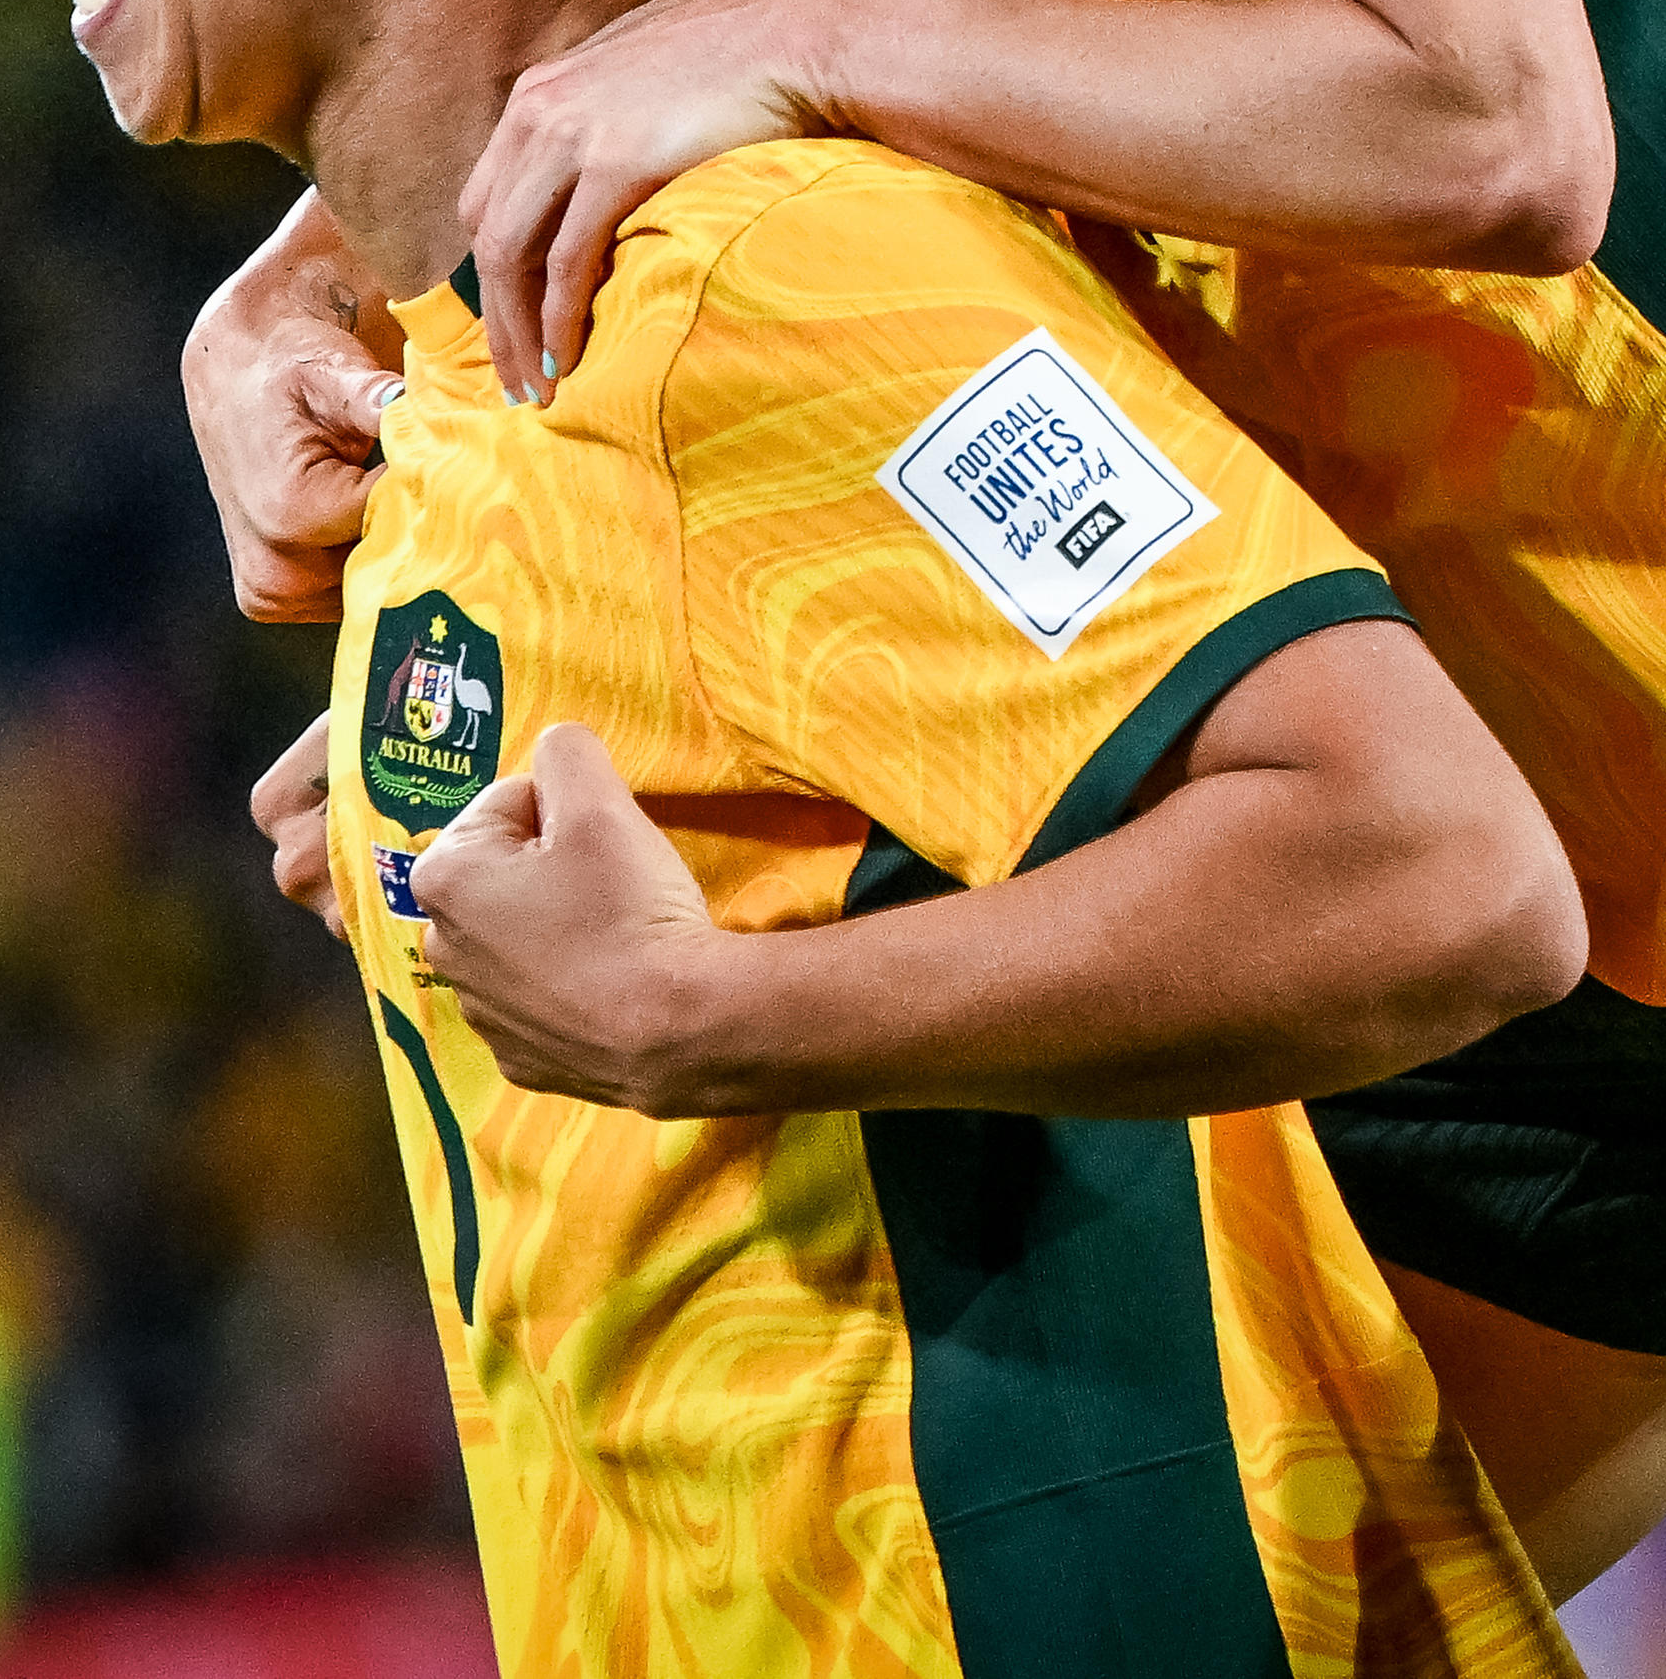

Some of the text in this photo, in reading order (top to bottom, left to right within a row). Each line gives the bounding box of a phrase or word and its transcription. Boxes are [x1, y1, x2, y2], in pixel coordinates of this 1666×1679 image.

[943, 393, 1054, 492] FOOTBALL
[969, 417, 1084, 525] UNITES
[1004, 447, 1120, 561] the World
[1065, 507, 1118, 560] FIFA
[378, 736, 471, 777] AUSTRALIA
